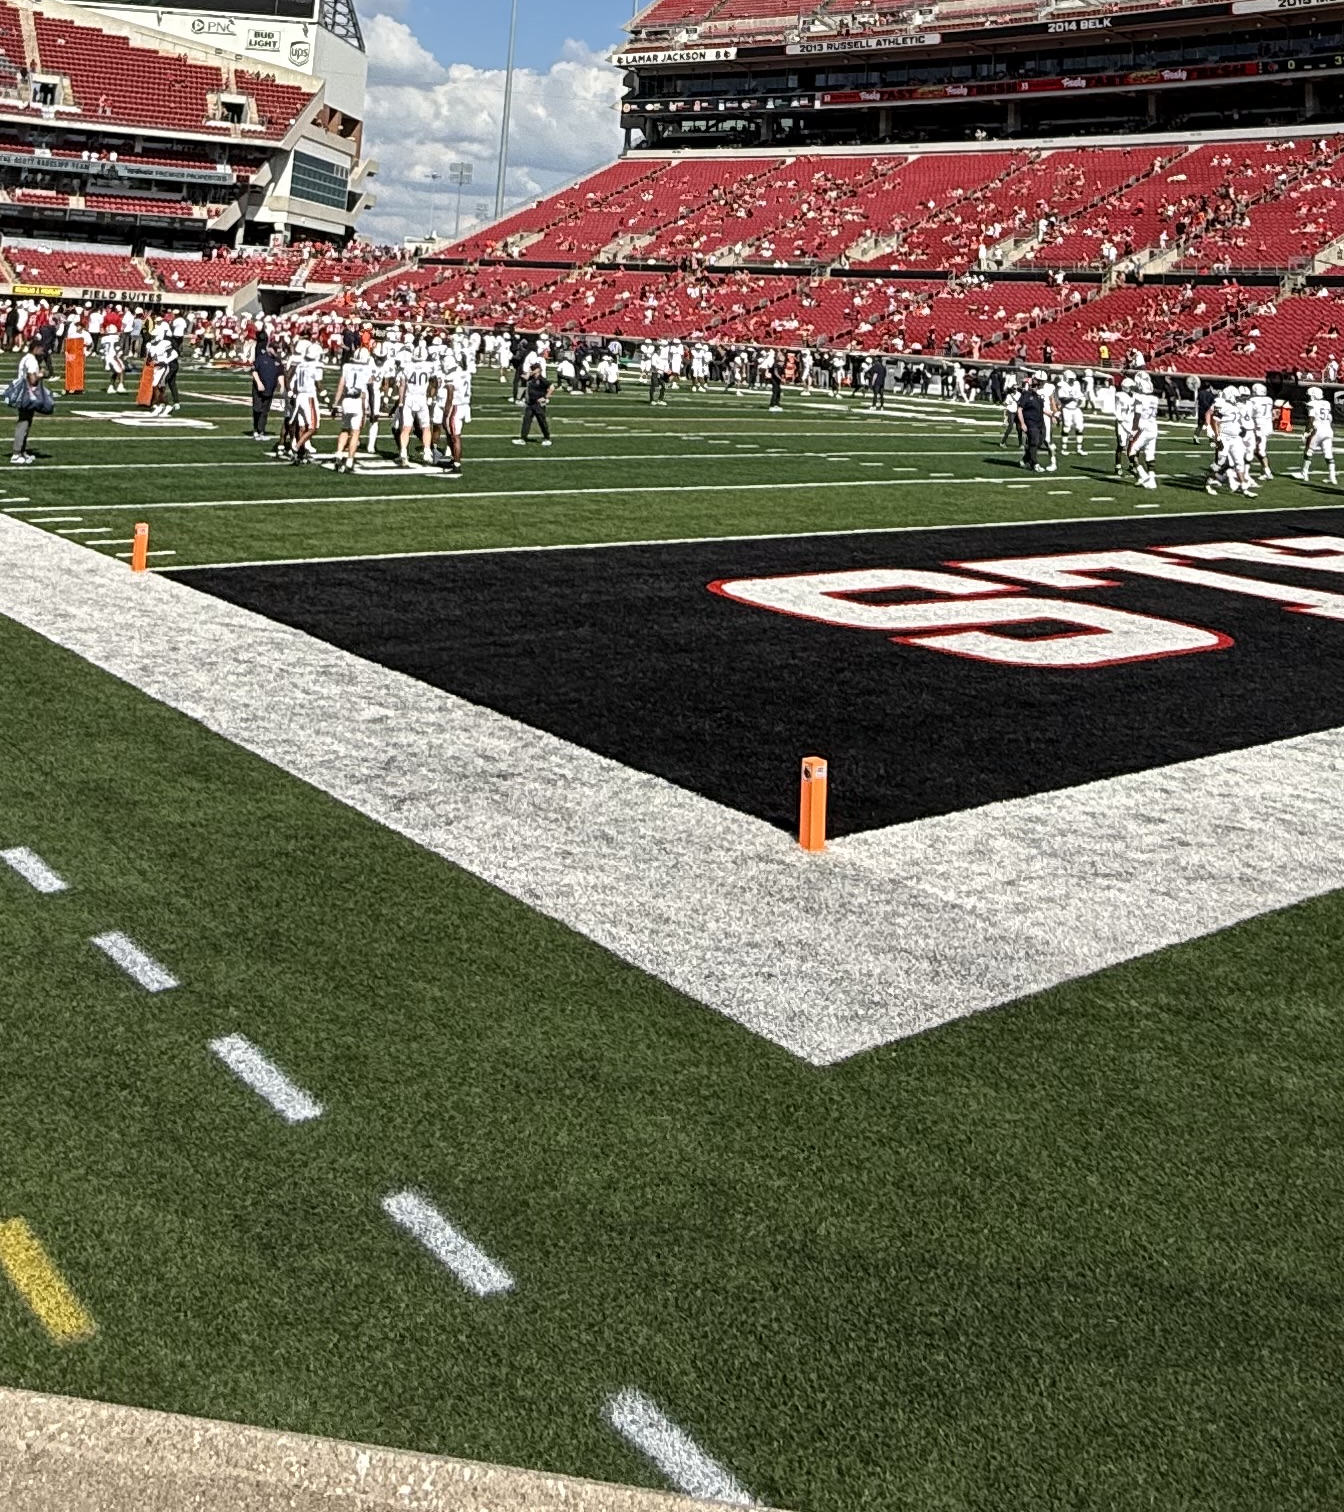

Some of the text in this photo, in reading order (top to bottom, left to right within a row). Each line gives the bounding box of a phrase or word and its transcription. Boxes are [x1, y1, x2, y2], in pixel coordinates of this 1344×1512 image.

[1047, 17, 1113, 33] 2014 BELK
[254, 31, 275, 39] BUD
[248, 39, 278, 48] LIGHT
[799, 35, 926, 52] 2013 RUSSELL ATHLETIC
[291, 47, 309, 60] ups
[625, 53, 658, 64] LAMAR
[661, 51, 706, 63] JACKSON
[82, 289, 163, 302] FIELD SUITES
[408, 371, 428, 385] 40
